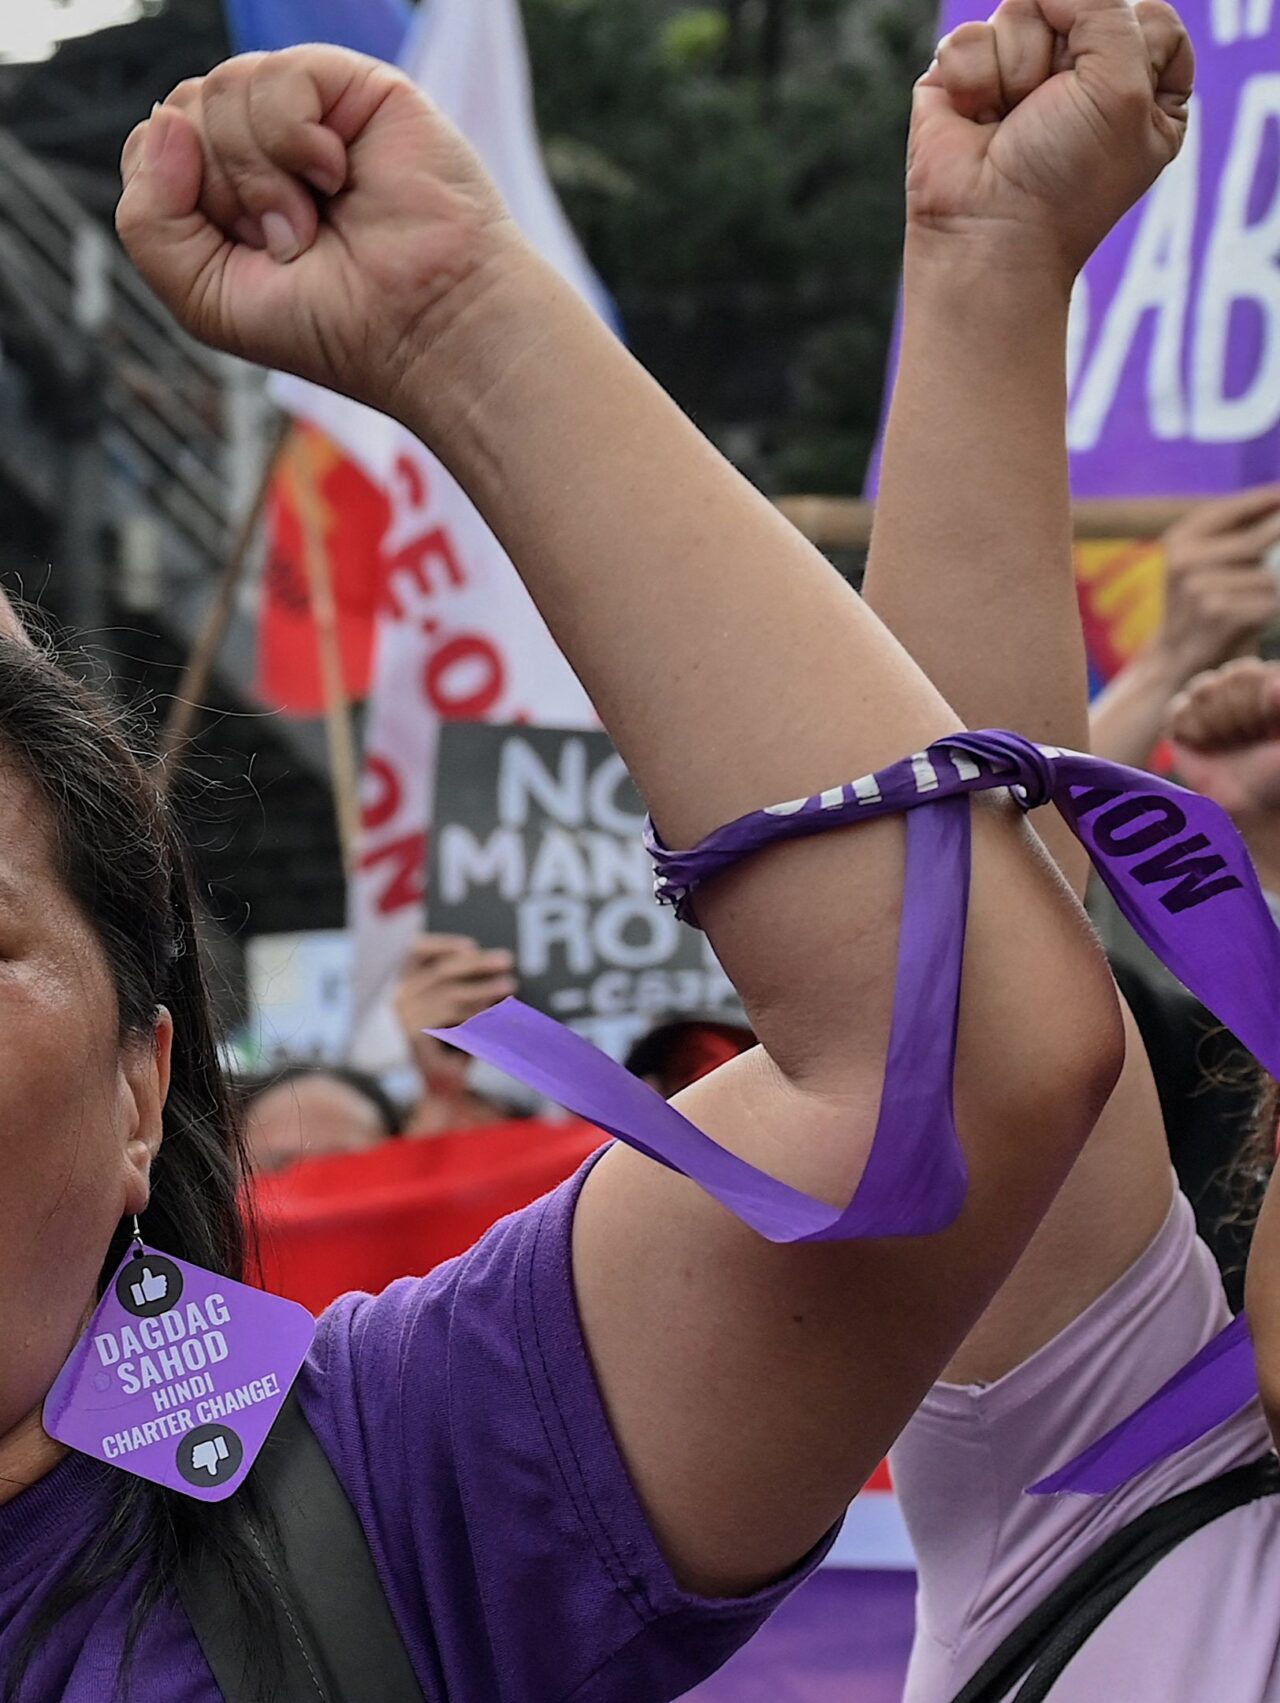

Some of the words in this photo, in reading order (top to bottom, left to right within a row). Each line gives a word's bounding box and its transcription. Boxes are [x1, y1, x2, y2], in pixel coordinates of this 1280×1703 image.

[94, 1293, 231, 1367] DAGDAG
[116, 1330, 229, 1395] SAHOD
[101, 1411, 194, 1459] CHARTER
[196, 1372, 281, 1423] CHANGE!
[152, 1372, 215, 1412] HINDI
